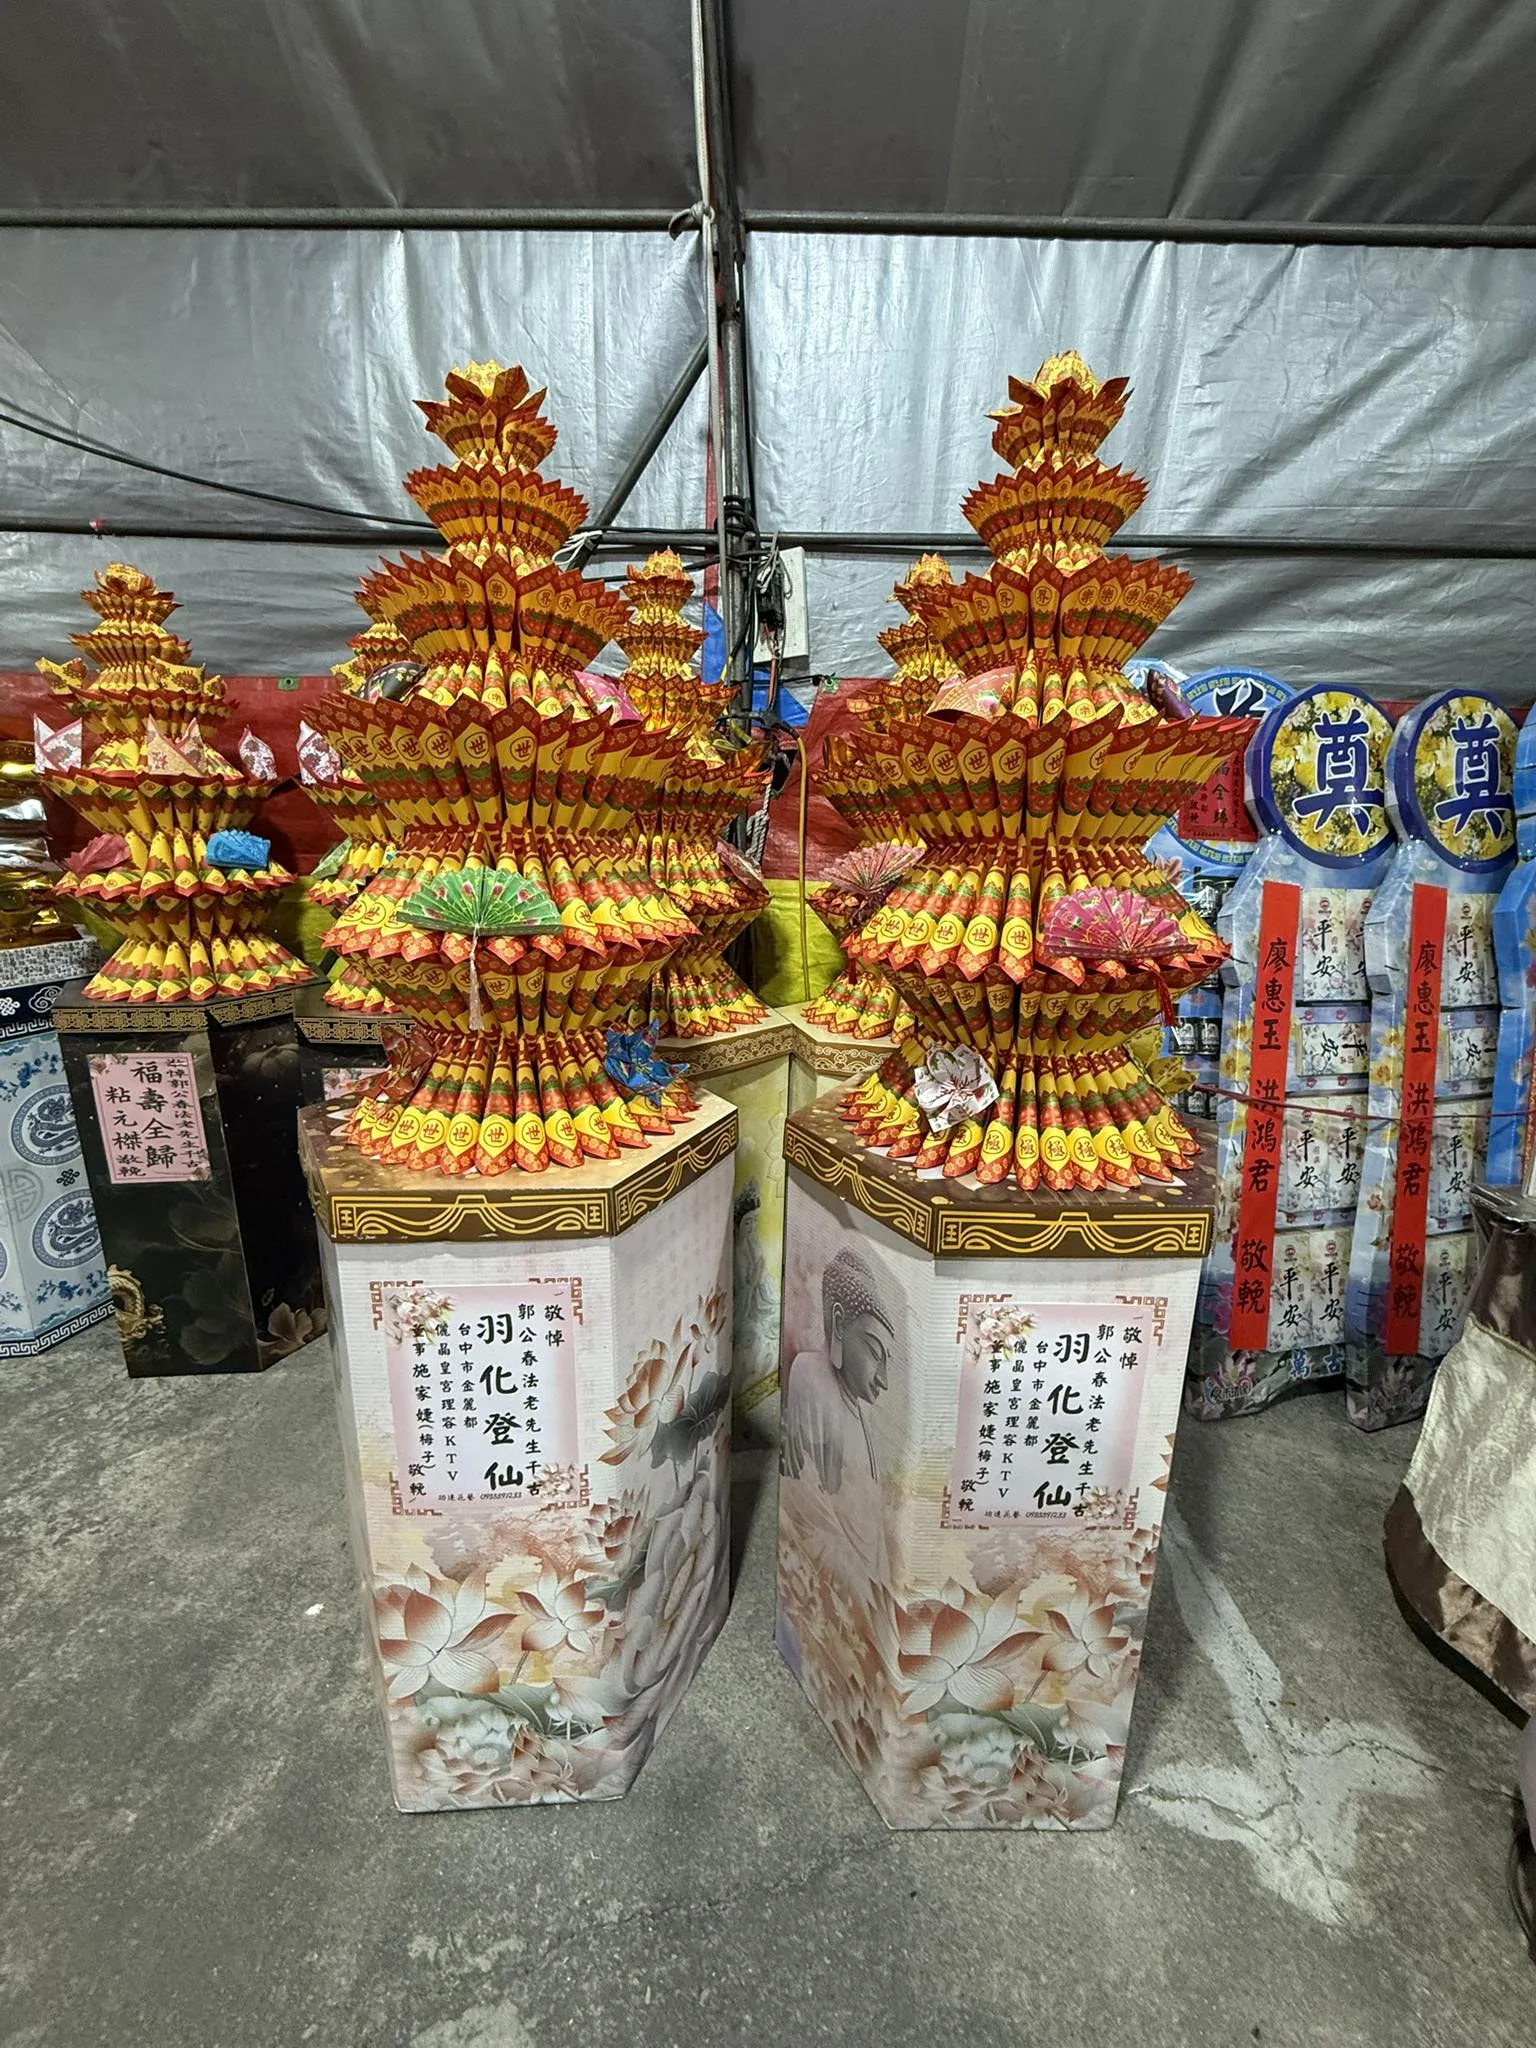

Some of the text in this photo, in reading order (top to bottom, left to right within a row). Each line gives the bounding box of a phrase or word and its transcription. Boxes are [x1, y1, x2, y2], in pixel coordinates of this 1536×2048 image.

[353, 740, 372, 758] 世
[402, 738, 421, 757] 世
[432, 735, 449, 755] 世
[470, 735, 486, 754] 世
[515, 740, 532, 758] 世
[884, 761, 899, 778] 世
[909, 754, 927, 772] 世
[969, 751, 986, 771] 世
[1005, 751, 1022, 770] 世
[1292, 708, 1386, 837] 奠
[1433, 711, 1515, 840] 奠
[885, 919, 900, 934] 世
[909, 922, 924, 938] 世
[936, 925, 953, 941] 世
[972, 927, 989, 943] 世
[1011, 930, 1028, 946] 世
[1311, 918, 1335, 978] 平安
[1455, 925, 1476, 984] 平安
[130, 1061, 178, 1168] 福壽全歸
[399, 1119, 414, 1136] 世
[423, 1123, 440, 1140] 世
[453, 1126, 469, 1142] 世
[488, 1126, 504, 1143] 世
[526, 1124, 541, 1141] 世
[561, 1120, 574, 1136] 世
[985, 1133, 1000, 1151] 極
[1019, 1138, 1035, 1155] 極
[1048, 1140, 1065, 1157] 極
[1078, 1141, 1095, 1158] 極
[1294, 1129, 1318, 1189] 平安
[1336, 1127, 1360, 1185] 平安
[1445, 1135, 1466, 1194] 平安
[1238, 1240, 1268, 1314] 敬輓
[1392, 1243, 1420, 1318] 敬輓
[1278, 1267, 1302, 1328] 平安
[1320, 1262, 1344, 1321] 平安
[1435, 1272, 1457, 1331] 平安
[545, 1304, 565, 1347] 敬悼
[1119, 1326, 1142, 1370] 敬悼
[459, 1323, 478, 1428] 台中市金麗都
[477, 1313, 524, 1490] 羽化登仙
[518, 1304, 542, 1496] 郭公春法老先生千古
[1024, 1341, 1049, 1447] 台中市金麗都
[1033, 1333, 1090, 1509] 羽化登仙
[1072, 1324, 1115, 1517] 郭公春法老先生千古
[408, 1464, 427, 1496] 敬輓
[958, 1479, 976, 1512] 敬輓
